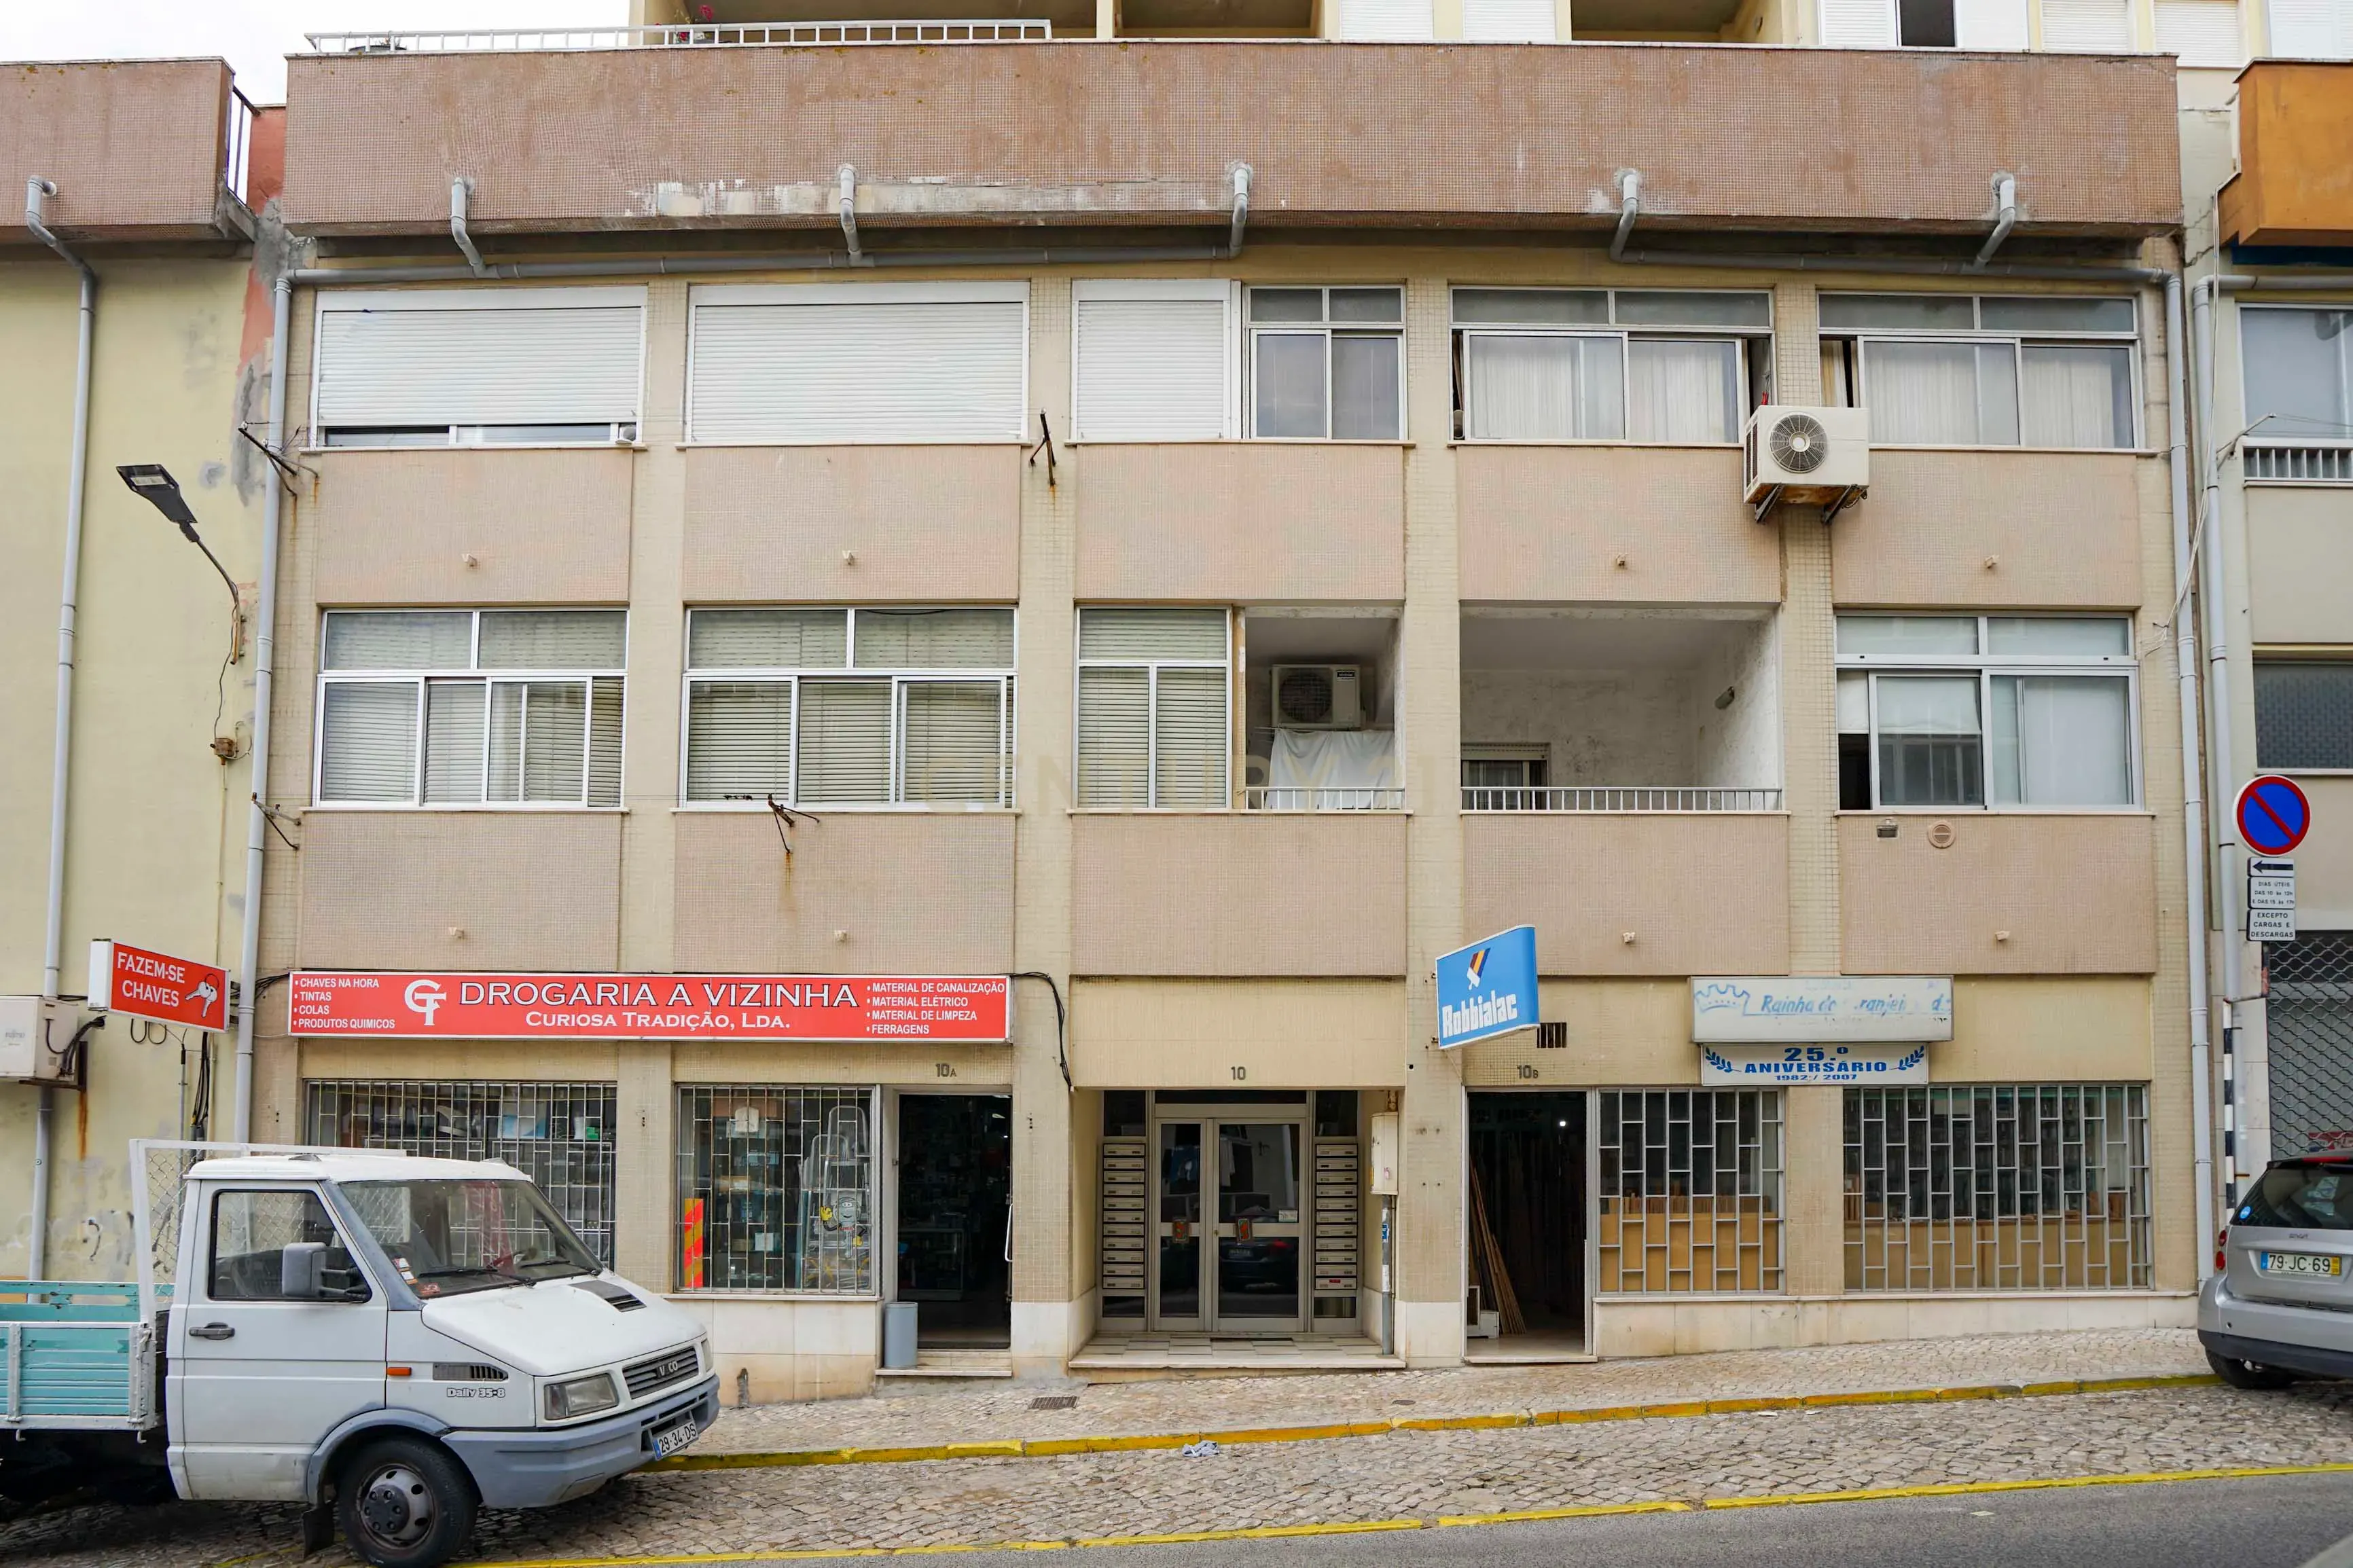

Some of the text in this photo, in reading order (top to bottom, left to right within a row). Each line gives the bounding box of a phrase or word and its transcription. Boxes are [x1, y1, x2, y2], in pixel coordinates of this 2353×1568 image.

[118, 951, 185, 983] FAZEM-SE
[300, 978, 380, 988] CHAVES NA HORA
[872, 982, 1005, 995] MATERIAL DE CANALIZAÇÃO
[122, 979, 179, 1007] CHAVES
[300, 991, 331, 1001] TINTAS
[460, 982, 859, 1007] DROGARIA A VIZINHA
[872, 995, 968, 1006] MATERIAL ELÉTRICO
[1761, 994, 1813, 1013] Rainha
[299, 1005, 329, 1015] COLAS
[872, 1010, 977, 1020] MATERIAL DE LIMPEZA
[1442, 989, 1517, 1038] Robbialac
[298, 1019, 395, 1029] PRODUTOS QUIMICOS
[872, 1024, 929, 1034] FERRAGENS
[1231, 1066, 1246, 1080] 10
[1745, 1061, 1887, 1073] ANIVERSÁRIO
[658, 1360, 678, 1376] VCO
